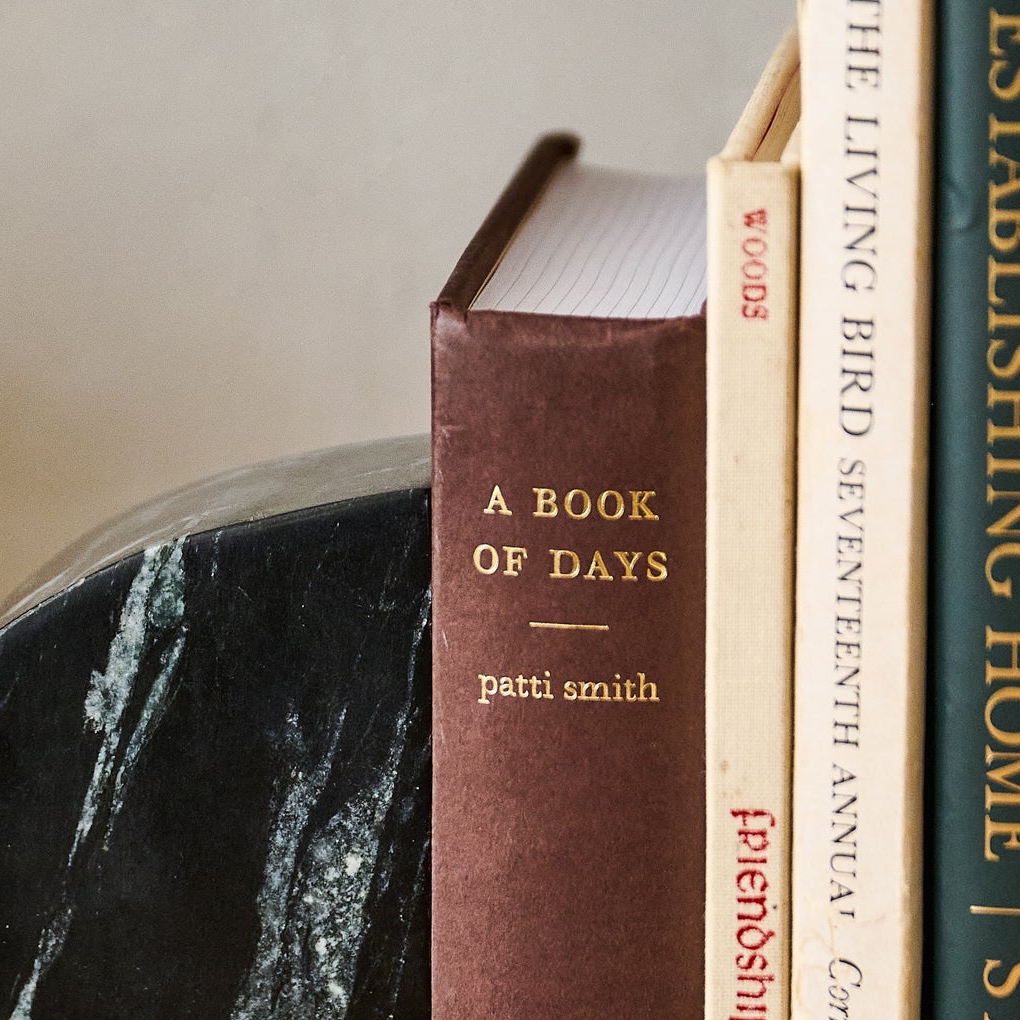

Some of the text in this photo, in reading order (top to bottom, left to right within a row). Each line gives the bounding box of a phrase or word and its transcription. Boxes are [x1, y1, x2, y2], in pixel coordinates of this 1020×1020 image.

[846, 0, 881, 89] THE
[841, 115, 879, 292] LIVING
[741, 208, 769, 321] WOODS
[839, 315, 875, 437] BIRD
[483, 484, 660, 521] A BOOK
[472, 543, 668, 582] OF DAYS
[833, 457, 866, 748] SEVENTEENTH
[477, 670, 661, 705] patti smith
[983, 625, 1020, 863] HOME
